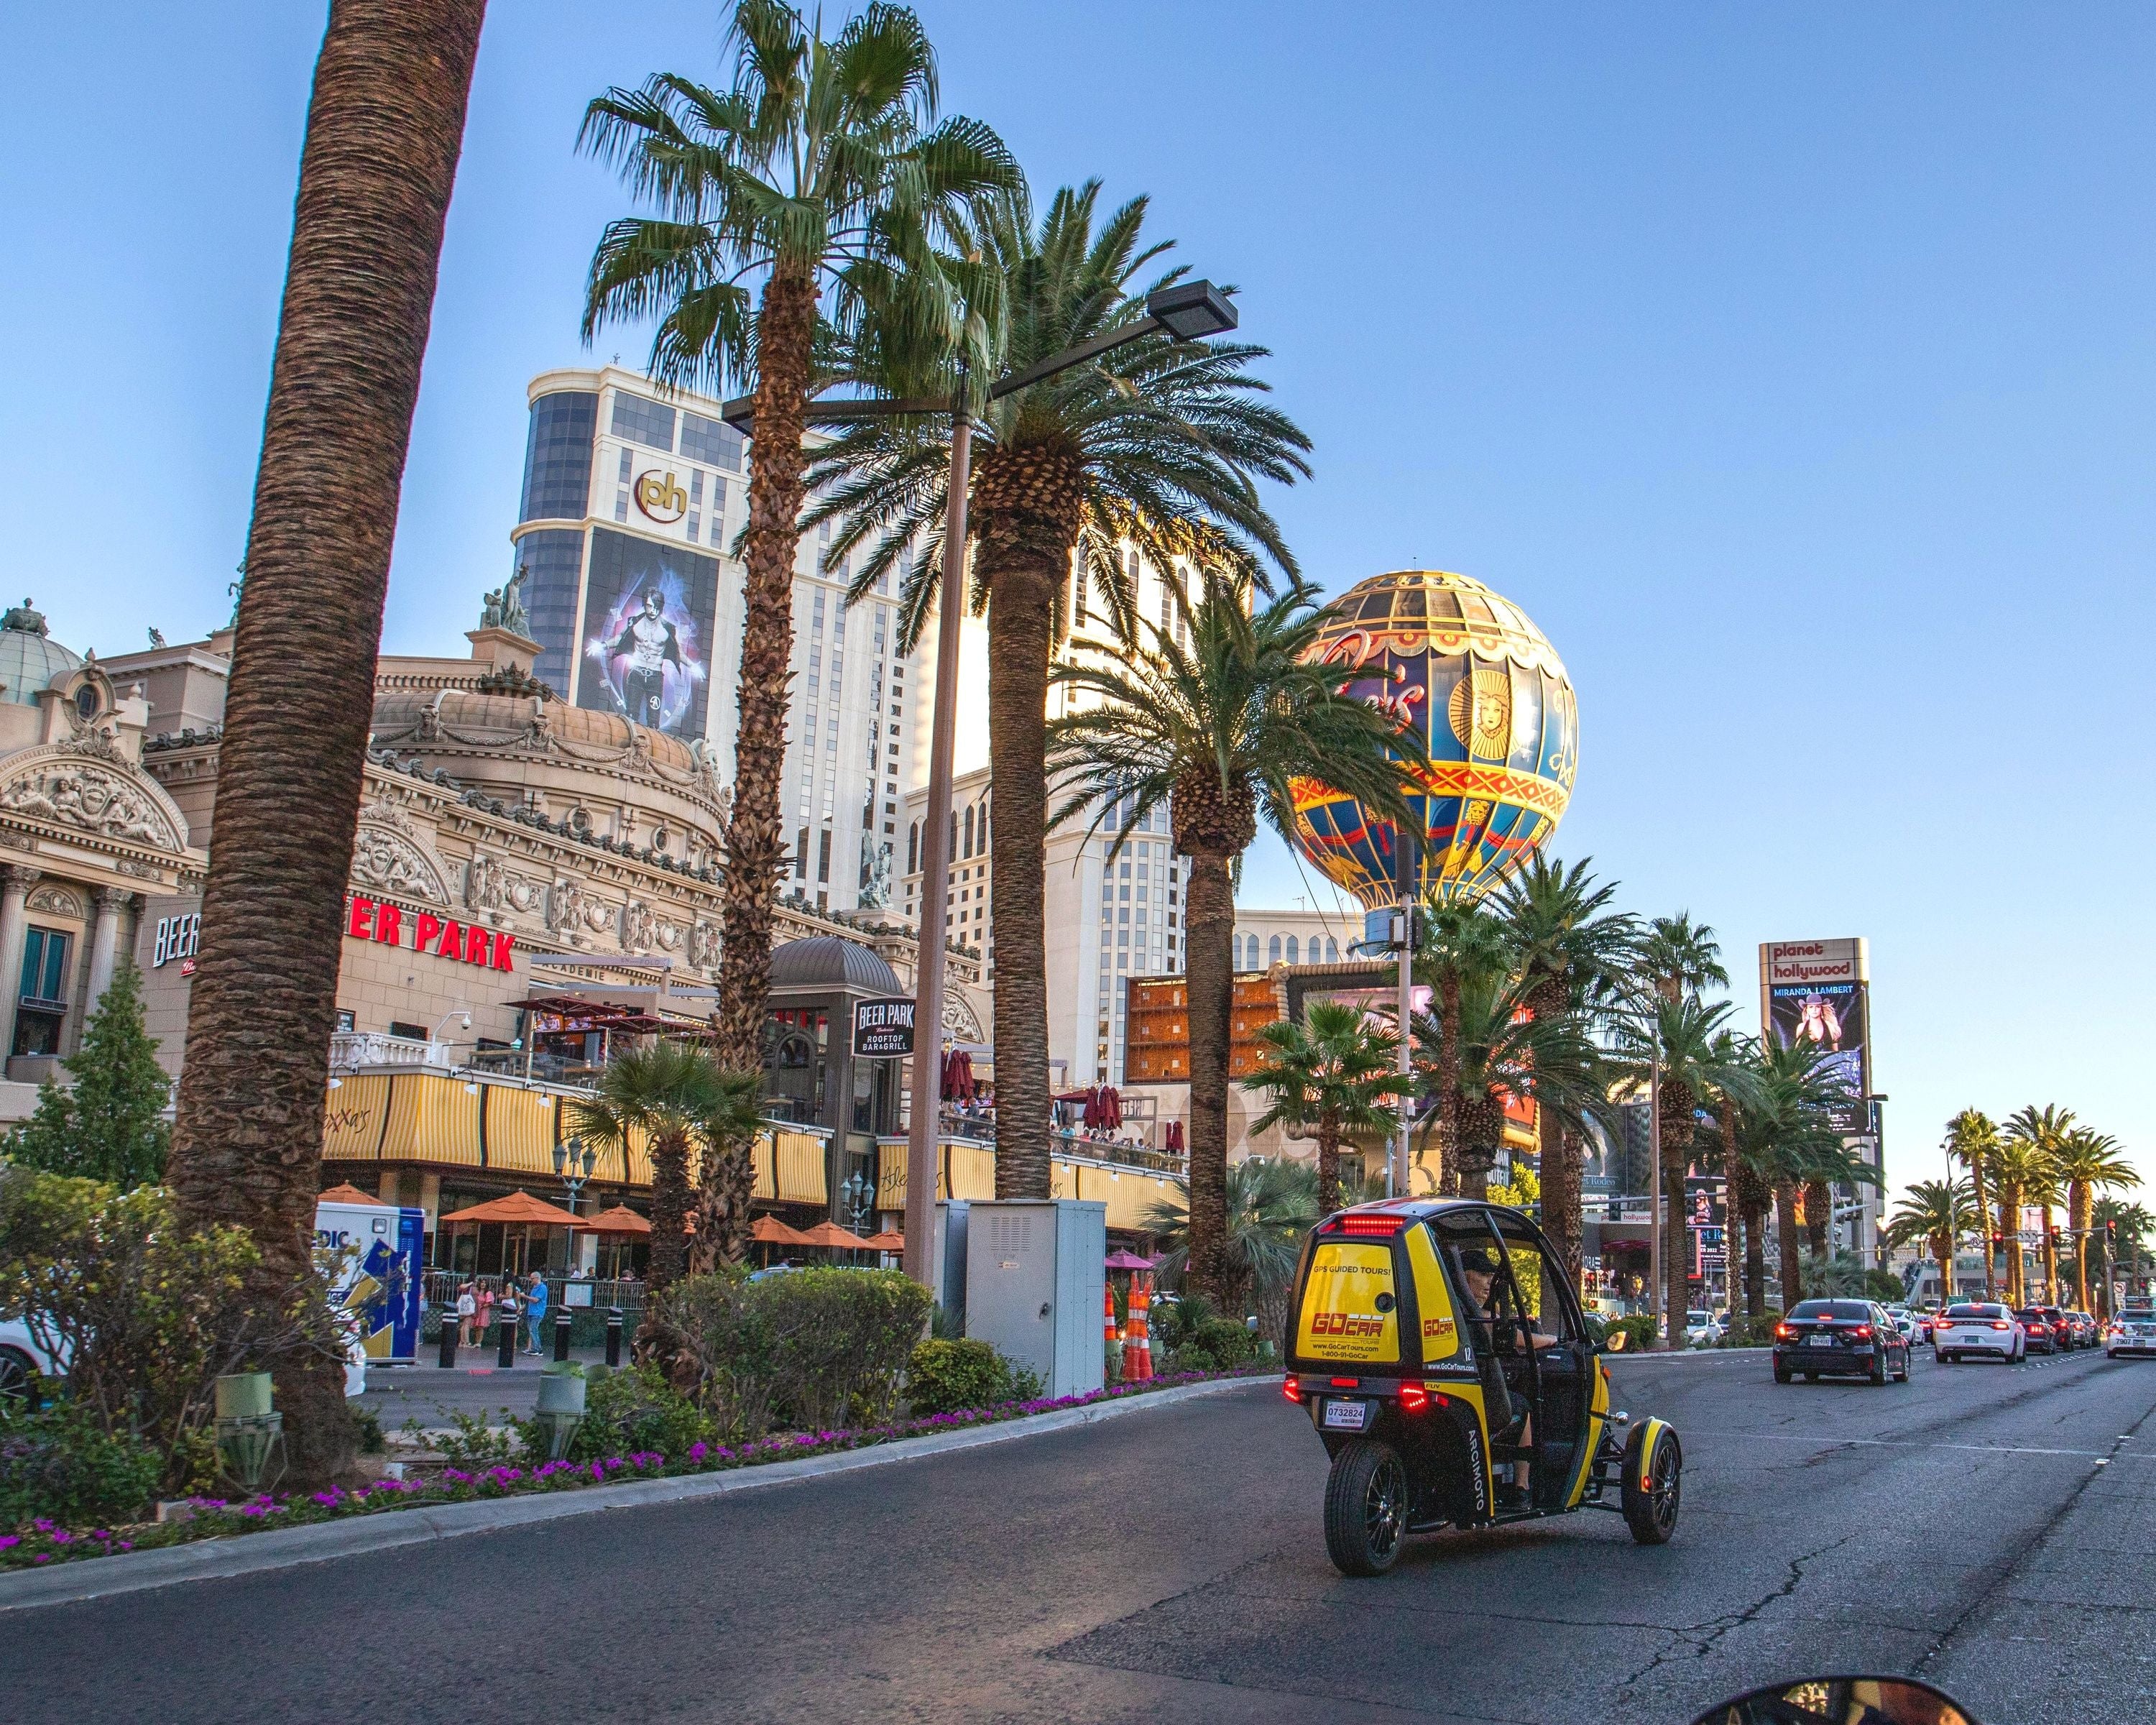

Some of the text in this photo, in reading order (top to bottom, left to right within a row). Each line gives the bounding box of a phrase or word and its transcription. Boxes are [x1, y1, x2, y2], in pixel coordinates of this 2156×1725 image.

[640, 472, 687, 513] ph
[153, 913, 202, 967] BEER
[344, 893, 516, 972] ER PARK
[1774, 943, 1823, 961] planet
[1774, 962, 1850, 980] hollywood
[1774, 985, 1853, 997] MIRANDA LAMBERT
[859, 1004, 915, 1030] BEER PARK
[863, 1042, 907, 1051] BAR&GRILL
[1360, 1266, 1391, 1276] TOURS!
[1313, 1343, 1378, 1352] www.GoCarTours.com
[1465, 1347, 1472, 1361] 12
[1428, 1363, 1475, 1372] www.GoCarTours.com
[1328, 1408, 1363, 1417] 0732824
[1468, 1430, 1484, 1511] ARCIMOTO
